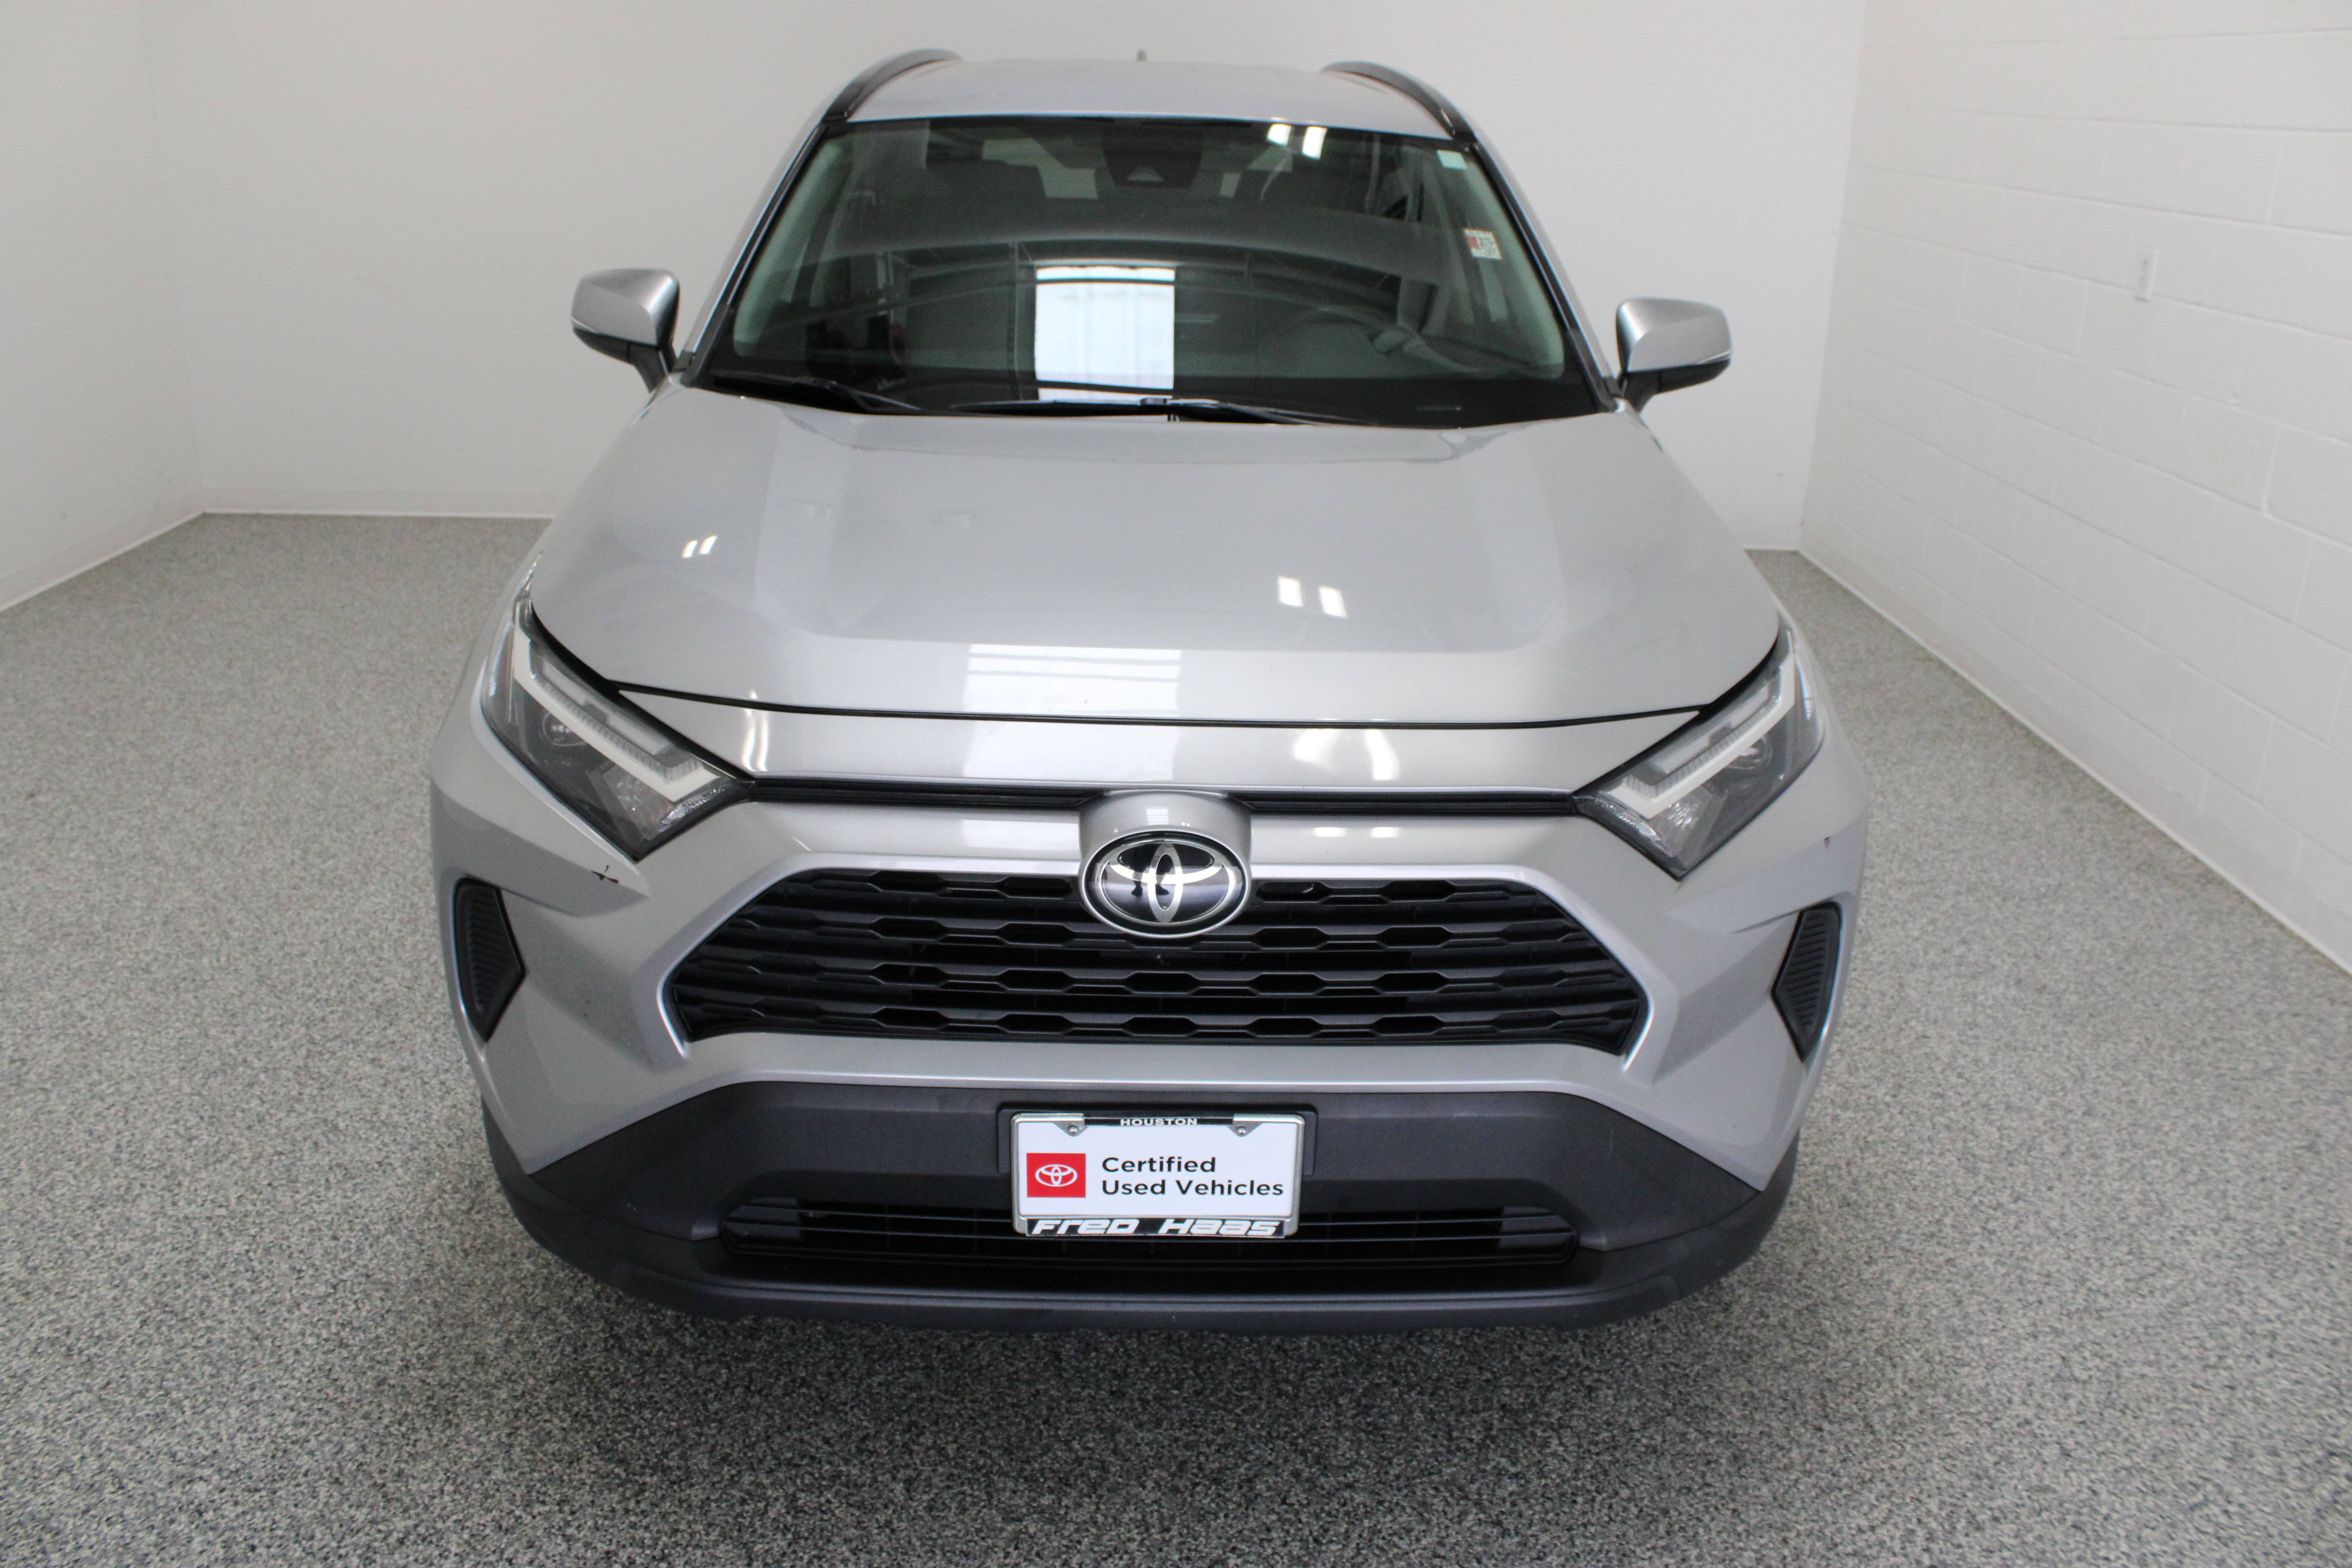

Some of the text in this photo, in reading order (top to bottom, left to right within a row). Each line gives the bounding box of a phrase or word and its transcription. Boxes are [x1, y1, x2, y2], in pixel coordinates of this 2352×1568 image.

[1102, 1157, 1216, 1172] Certified
[1102, 1179, 1284, 1195] Used Vehicles
